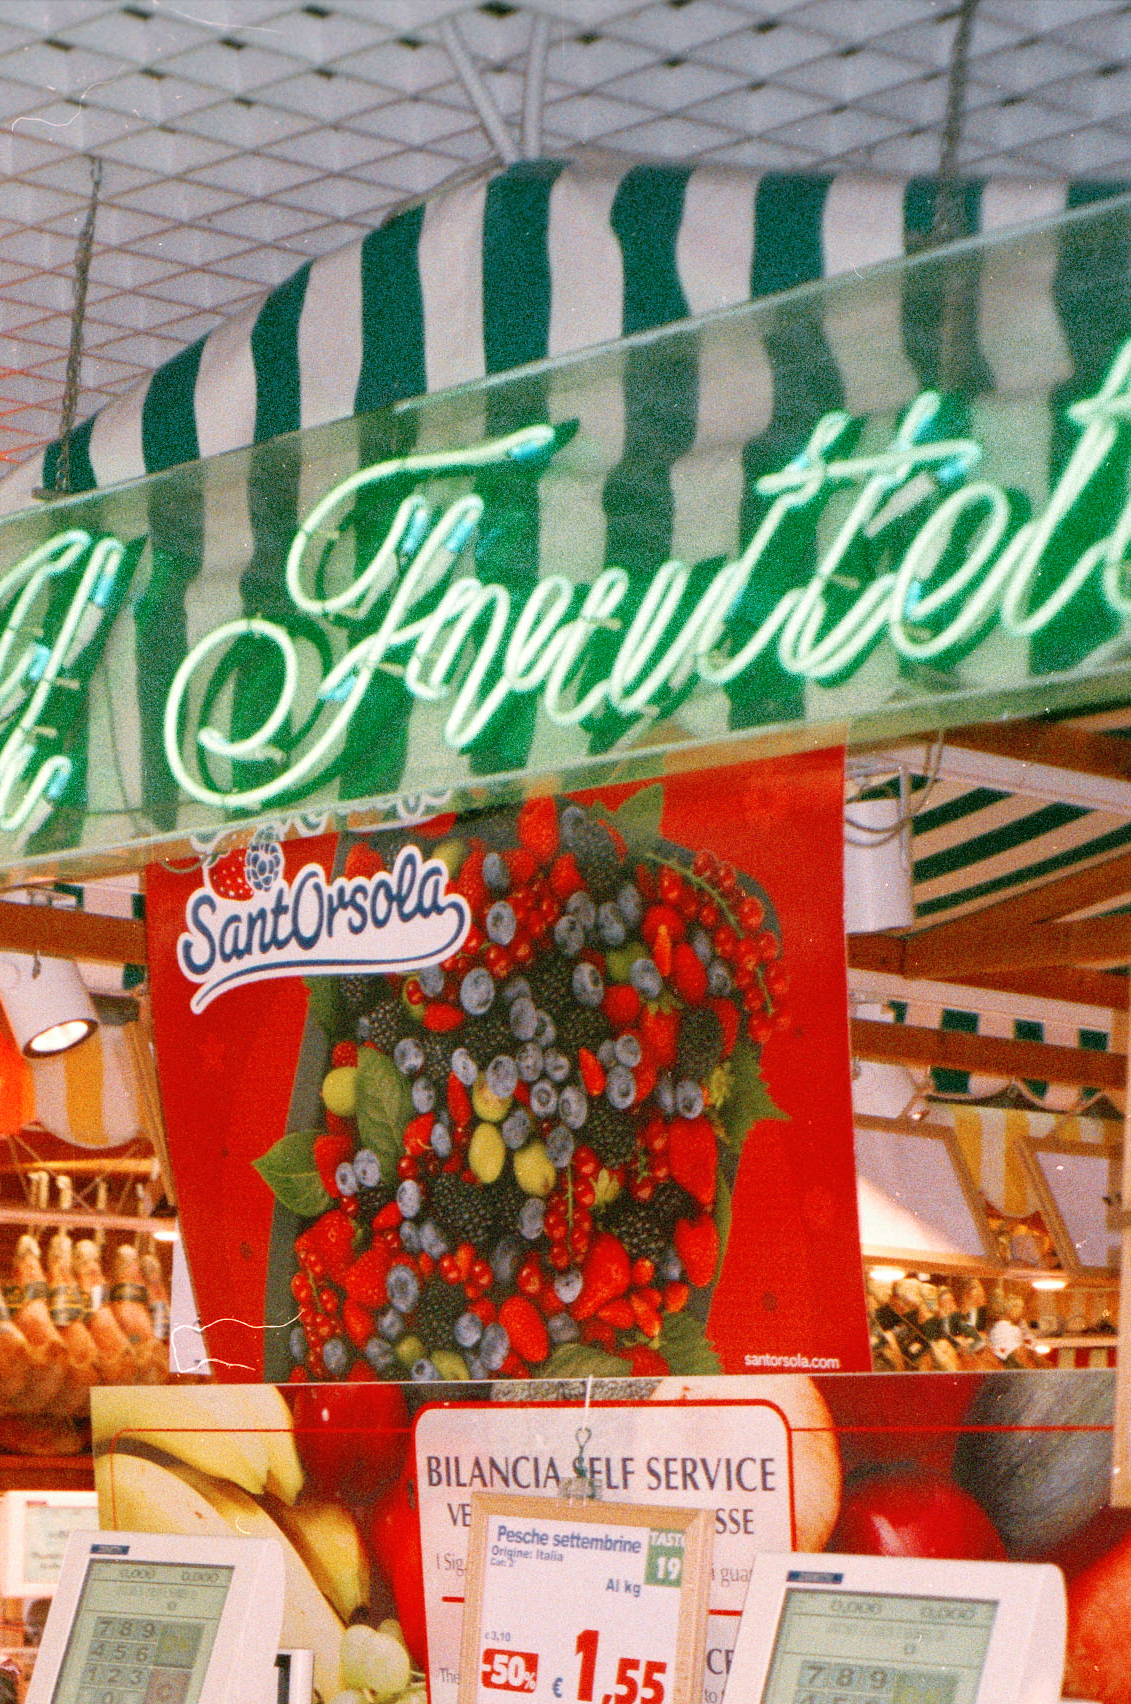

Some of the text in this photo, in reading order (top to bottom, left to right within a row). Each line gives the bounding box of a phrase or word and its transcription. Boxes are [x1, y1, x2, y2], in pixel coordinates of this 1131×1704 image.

[181, 851, 451, 976] SantOrsola
[743, 1353, 841, 1369] santorsola.com
[426, 1455, 776, 1492] BILANCIA SELF SERVICE
[497, 1524, 549, 1546] Pesche
[553, 1530, 642, 1554] settembrine
[491, 1545, 564, 1562] Origine: Italia
[657, 1556, 681, 1580] 19
[605, 1578, 642, 1598] Al kg
[119, 1620, 135, 1636] 8
[140, 1622, 156, 1638] 9
[113, 1645, 127, 1661] 5
[134, 1647, 149, 1663] 6
[106, 1667, 119, 1684] 2
[129, 1669, 144, 1686] 3
[481, 1653, 537, 1690] -50%
[552, 1677, 564, 1698] €
[807, 1665, 887, 1689] 7 8 9
